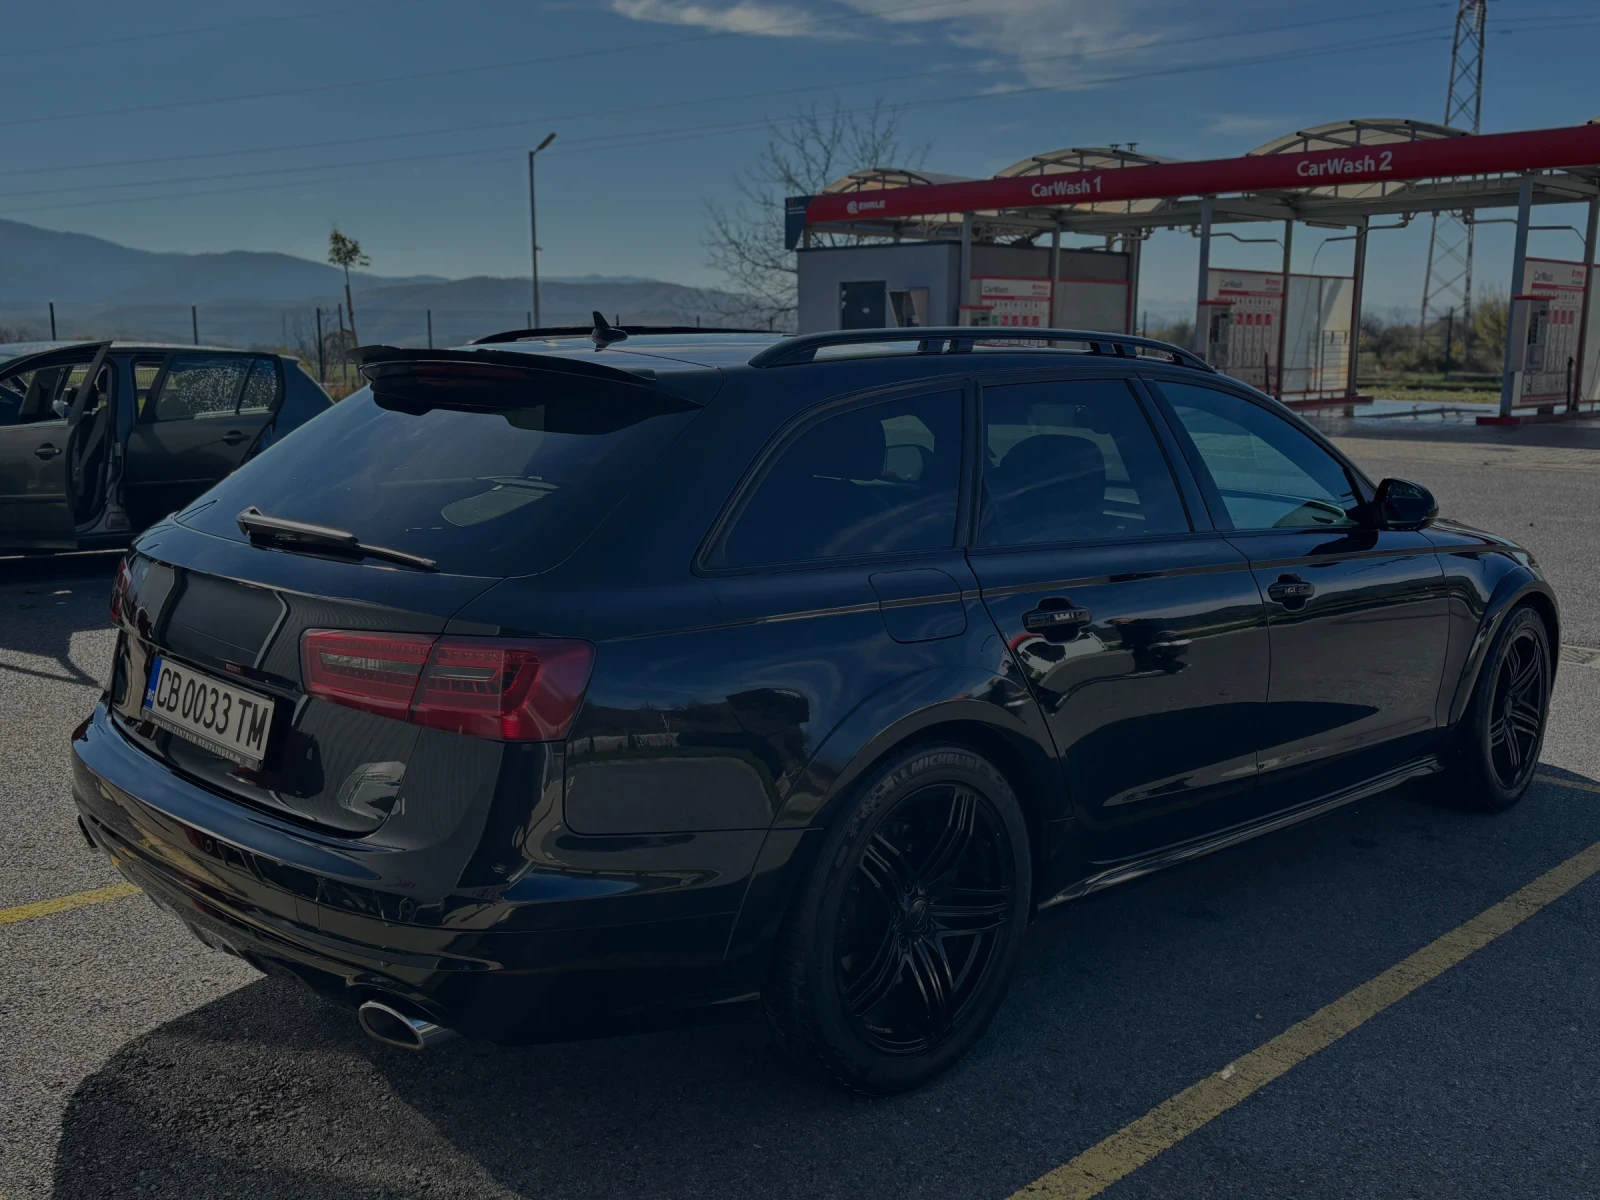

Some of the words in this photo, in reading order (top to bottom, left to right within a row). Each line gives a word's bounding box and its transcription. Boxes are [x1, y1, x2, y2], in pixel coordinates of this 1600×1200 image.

[1296, 155, 1376, 177] CarWash
[1378, 150, 1394, 172] 2
[1031, 179, 1091, 198] CarWash
[1093, 175, 1103, 194] 1
[157, 667, 182, 713] CB
[182, 678, 232, 735] 0033
[235, 697, 269, 751] TM
[911, 752, 977, 775] MICHELIN
